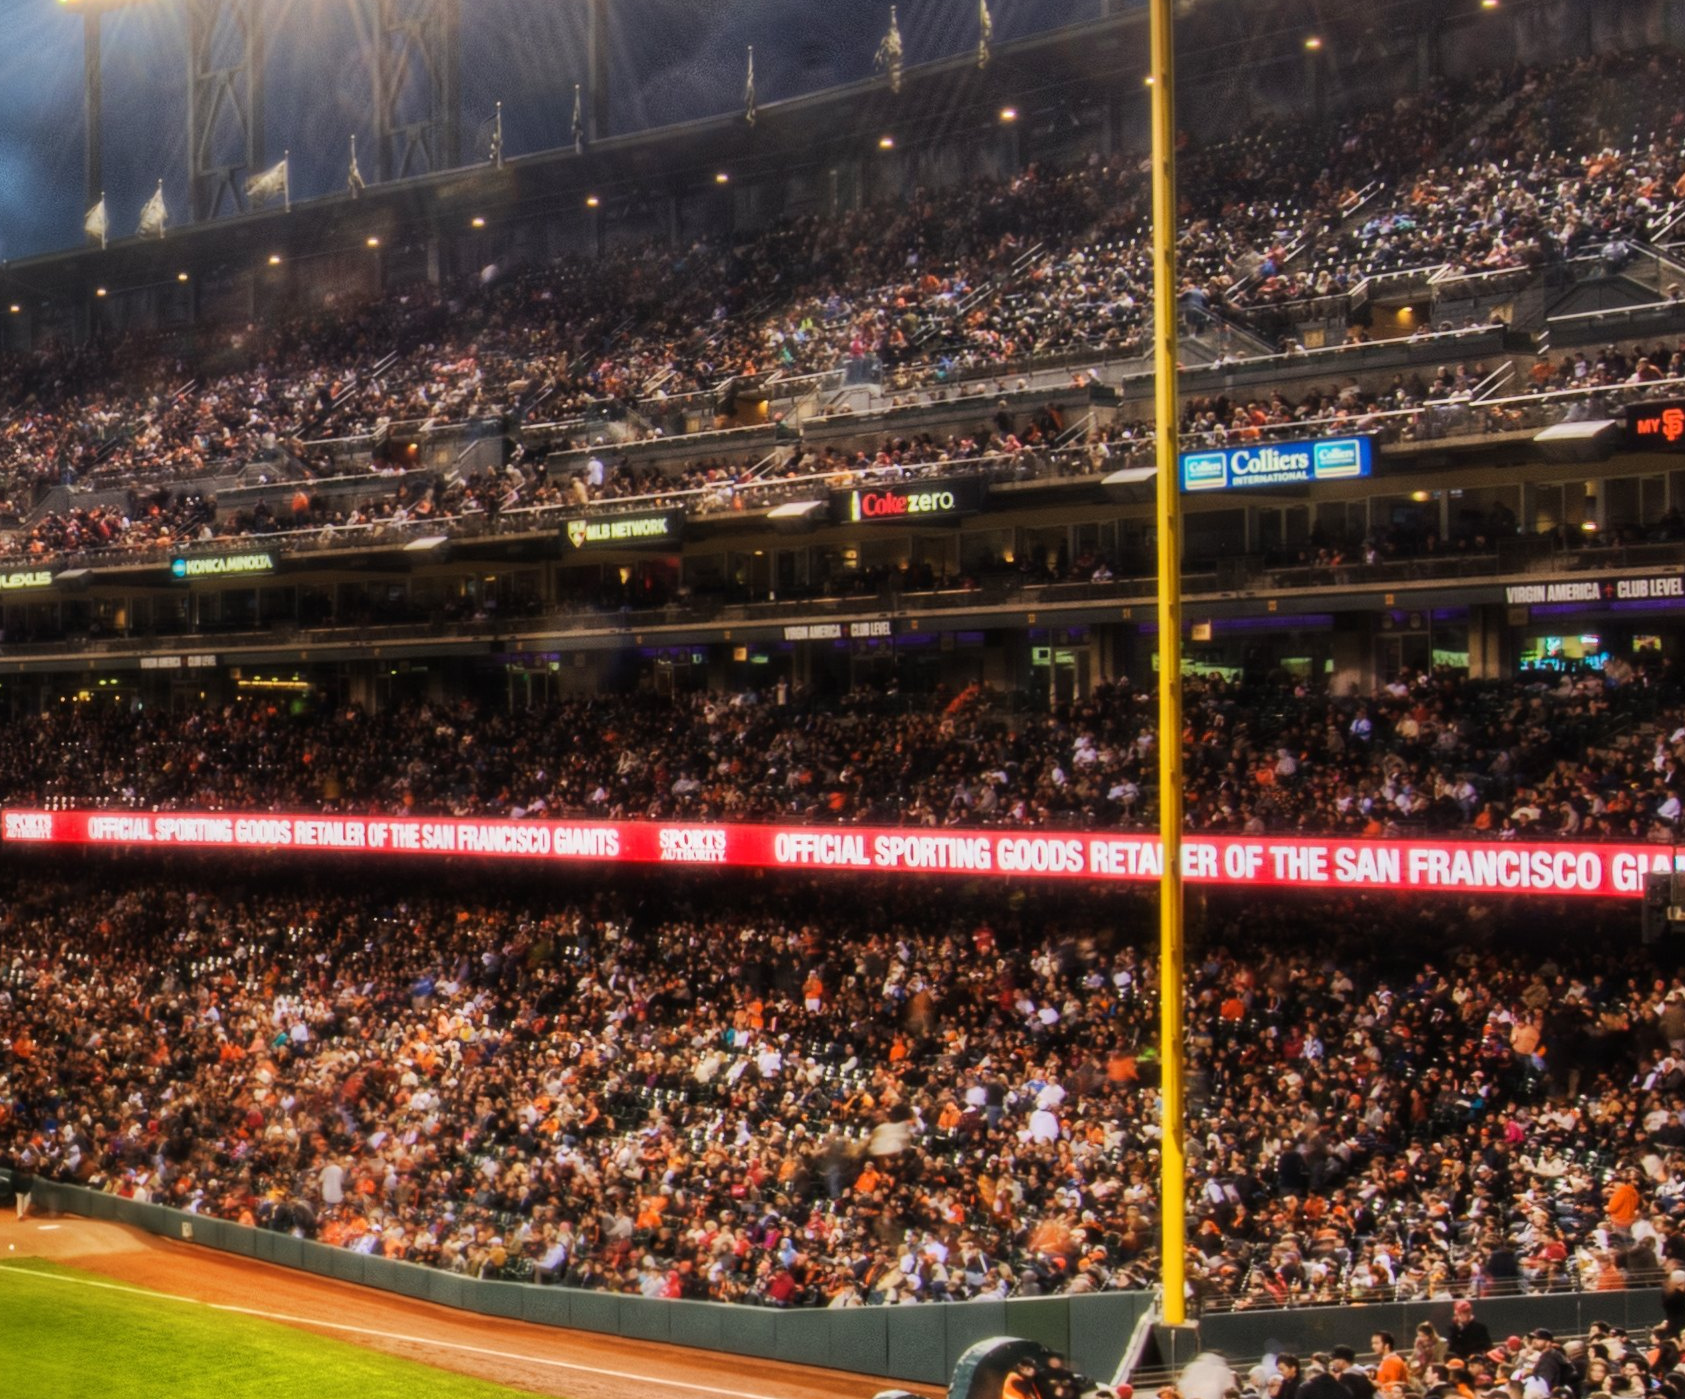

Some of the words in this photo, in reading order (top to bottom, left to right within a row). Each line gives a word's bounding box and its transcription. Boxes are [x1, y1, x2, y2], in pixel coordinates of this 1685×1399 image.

[1637, 418, 1660, 434] MY
[1230, 448, 1309, 475] Colliers
[1232, 470, 1310, 487] INTERNATIONAL
[862, 491, 907, 516] Coke
[907, 491, 954, 512] zero
[586, 523, 610, 541] MLB
[611, 518, 668, 539] NETWORK
[186, 558, 226, 575] KONICA
[227, 554, 273, 573] MINOLTA
[0, 571, 52, 589] LEXUS
[1506, 585, 1546, 604] VIRGIN
[1547, 582, 1601, 602] AMERICA
[1617, 579, 1649, 599] CLUB
[1650, 577, 1685, 597] LEVEL
[851, 622, 870, 637] CLUB
[870, 621, 891, 636] LEVEL
[5, 813, 52, 829] SPORTS
[88, 816, 153, 840] OFFICIAL
[155, 817, 233, 843] SPORTING
[234, 819, 292, 844] GOODS
[294, 820, 366, 847] RETAILER
[368, 822, 388, 848] OF
[389, 823, 420, 849] THE
[421, 824, 455, 850] SAN
[457, 825, 551, 854] FRANCISCO
[554, 827, 620, 856] GIANTS
[659, 829, 727, 849] SPORTS
[660, 847, 727, 862] AUTHORITY
[774, 833, 871, 865] OFFICIAL
[874, 836, 991, 870] SPORTING
[997, 838, 1084, 872] GOODS
[1089, 840, 1218, 877] RETAIER
[1225, 844, 1263, 879] OF
[1269, 846, 1329, 881] THE
[1335, 847, 1399, 883] SAN
[1408, 849, 1602, 889] FRANCISCO
